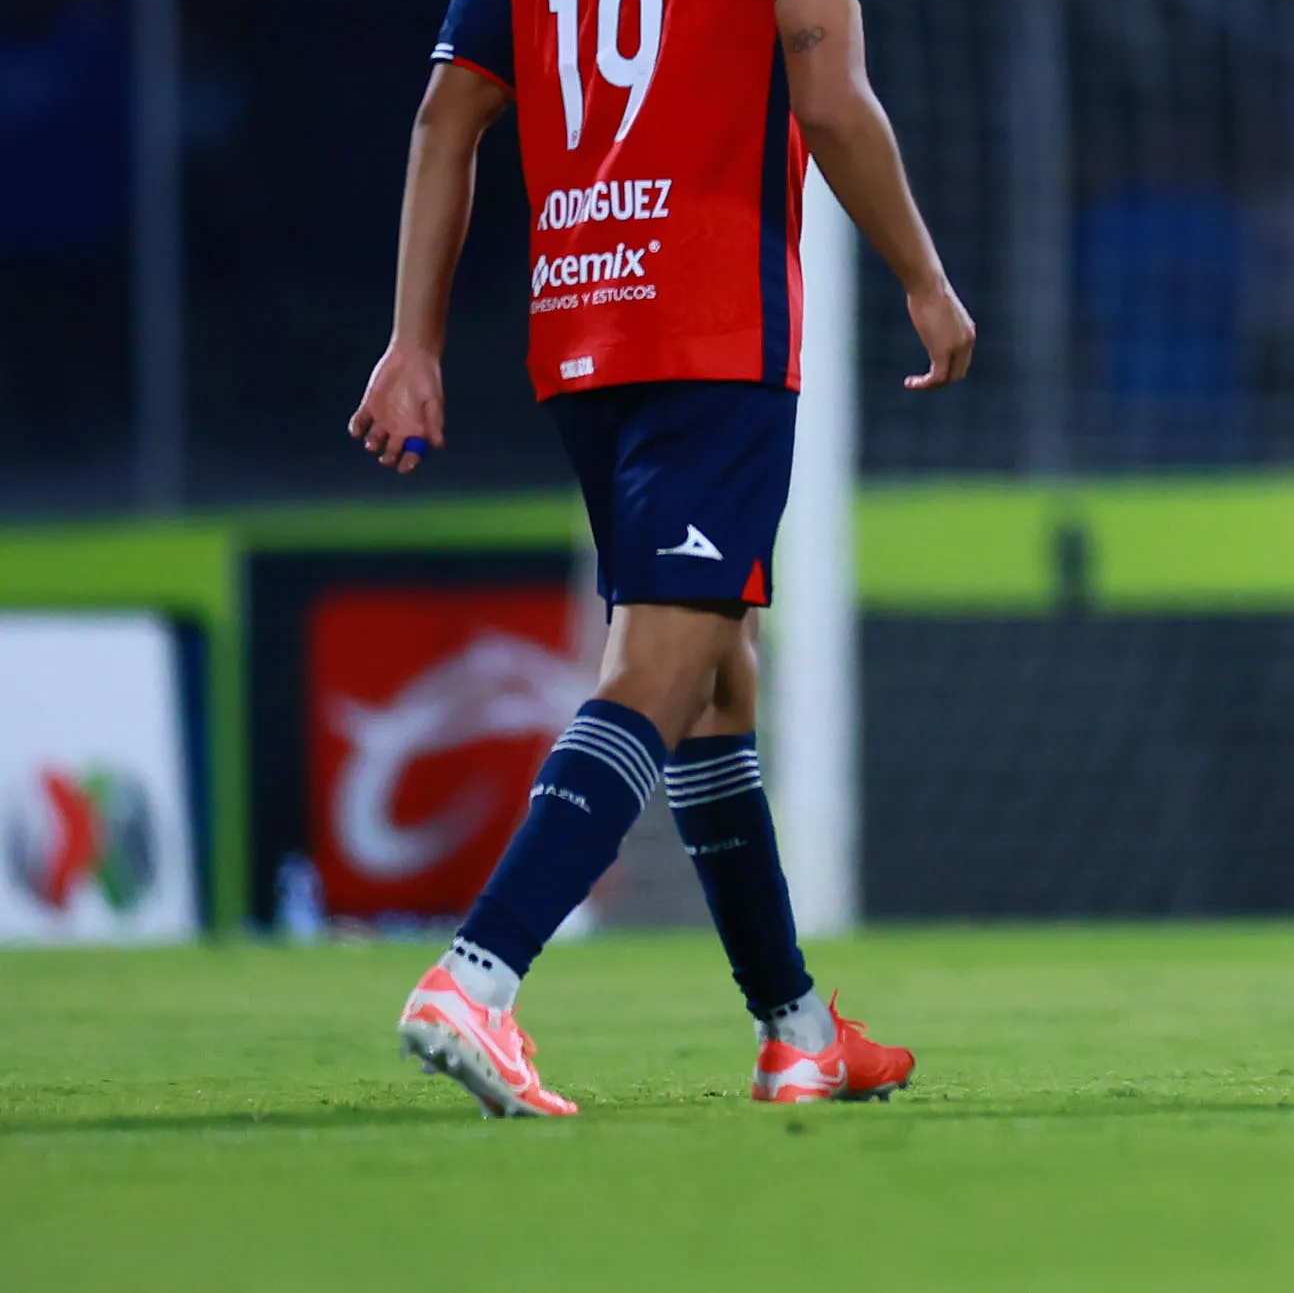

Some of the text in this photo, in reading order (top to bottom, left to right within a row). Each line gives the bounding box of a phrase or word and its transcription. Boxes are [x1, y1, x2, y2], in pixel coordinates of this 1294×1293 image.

[547, 242, 646, 288] cemix
[581, 292, 590, 307] Y
[591, 284, 657, 305] ESTUCOS
